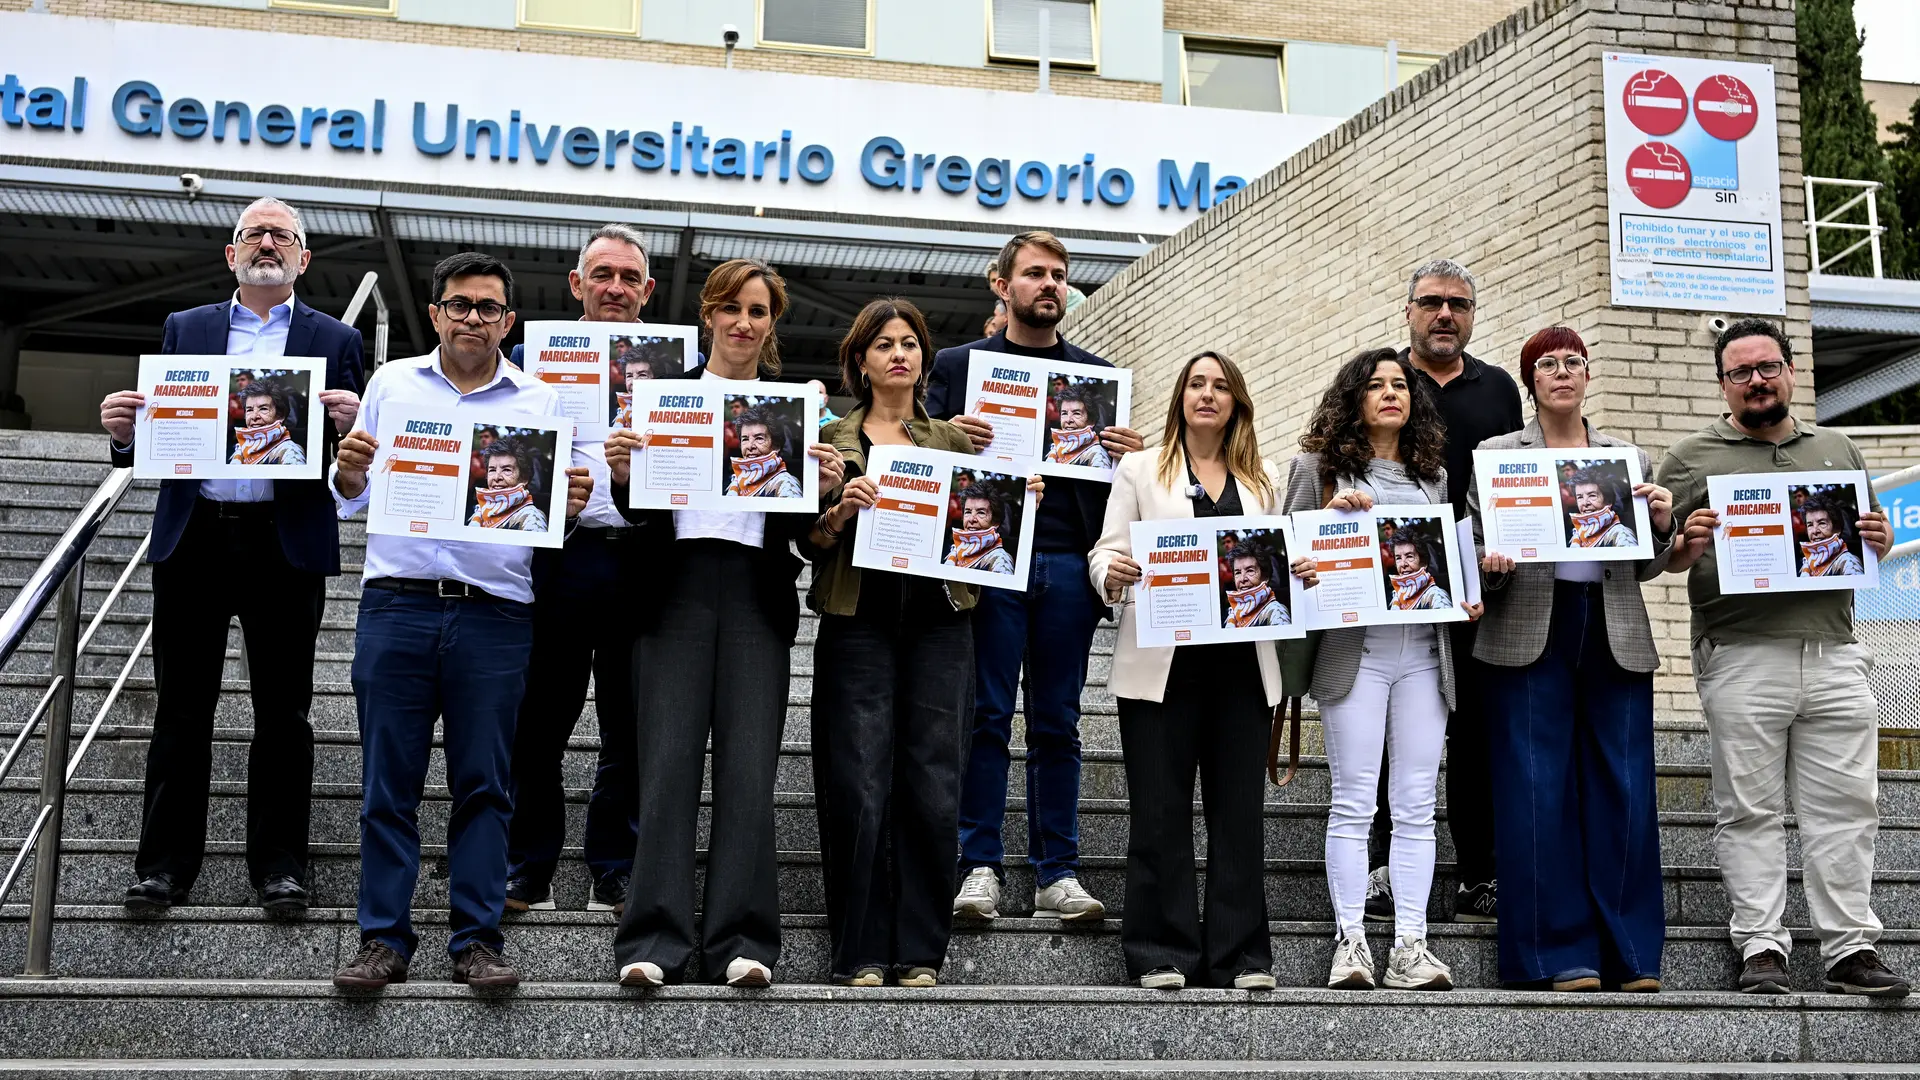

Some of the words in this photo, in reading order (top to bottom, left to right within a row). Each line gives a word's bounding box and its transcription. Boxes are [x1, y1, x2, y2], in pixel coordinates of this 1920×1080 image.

[112, 80, 386, 152] General
[412, 100, 834, 183] Universitario
[860, 135, 1134, 208] Gregorio
[1693, 175, 1736, 188] espacio
[1715, 188, 1737, 203] sin
[1625, 221, 1673, 233] Prohibido
[1678, 225, 1706, 235] fumar
[1710, 229, 1716, 237] y
[1720, 228, 1728, 236] el
[1754, 231, 1766, 239] de
[1626, 234, 1675, 244] cigarrillos
[1684, 238, 1746, 249] electrónicos
[1654, 248, 1662, 256] el
[1667, 248, 1701, 258] recinto
[1706, 251, 1767, 263] hospitalario.
[1631, 289, 1643, 297] Ley
[549, 336, 590, 348] DECRETO
[539, 351, 600, 363] MARICARMEN
[165, 370, 209, 382] DECRETO
[992, 367, 1030, 382] DECRETO
[153, 385, 219, 397] MARICARMEN
[982, 381, 1038, 398] MARICARMEN
[659, 396, 703, 408] DECRETO
[648, 411, 714, 424] MARICARMEN
[405, 420, 452, 436] DECRETO
[393, 435, 461, 453] MARICARMEN
[890, 460, 933, 477] DECRETO
[1499, 463, 1537, 474] DECRETO
[879, 474, 941, 494] MARICARMEN
[1492, 476, 1549, 488] MARICARMEN
[1734, 489, 1771, 501] DECRETO
[1726, 503, 1781, 516] MARICARMEN
[1319, 522, 1358, 536] DECRETO
[1157, 534, 1198, 548] DECRETO
[1312, 536, 1370, 551] MARICARMEN
[1149, 549, 1208, 564] MARICARMEN
